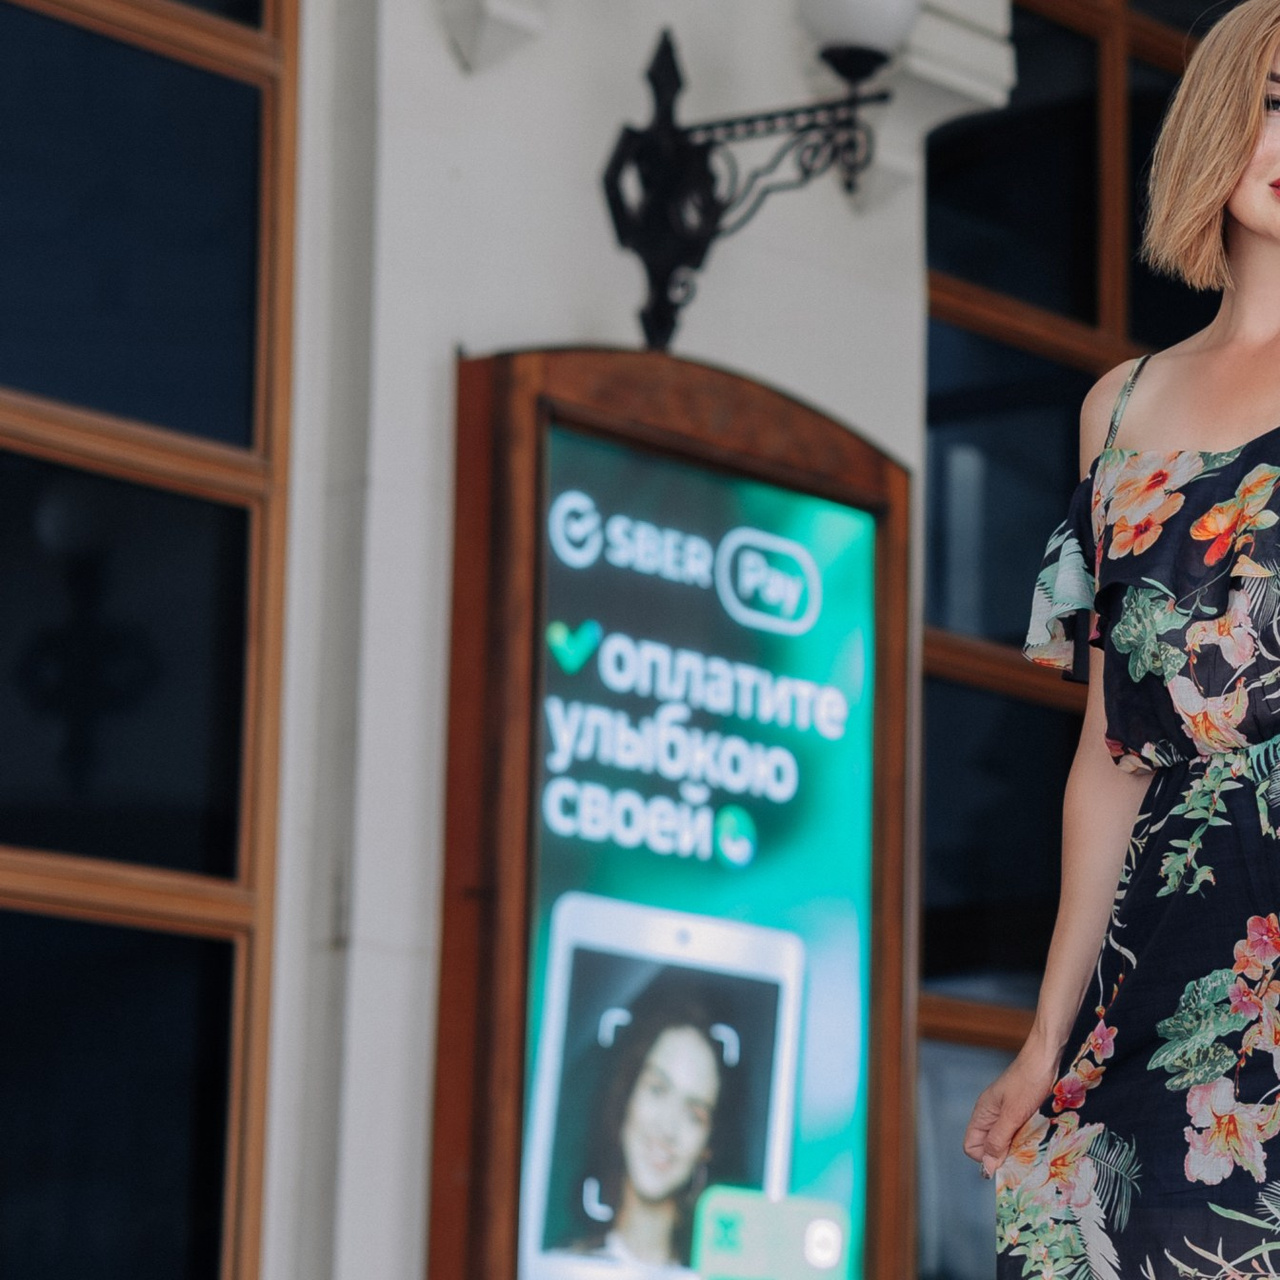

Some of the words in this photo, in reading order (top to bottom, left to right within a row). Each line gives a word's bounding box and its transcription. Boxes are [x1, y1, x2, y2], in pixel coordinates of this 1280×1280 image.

[604, 514, 715, 589] SBER
[736, 548, 804, 620] Pay
[598, 632, 849, 740] оплатите
[544, 695, 799, 804] улыбкою
[542, 776, 715, 862] своей
